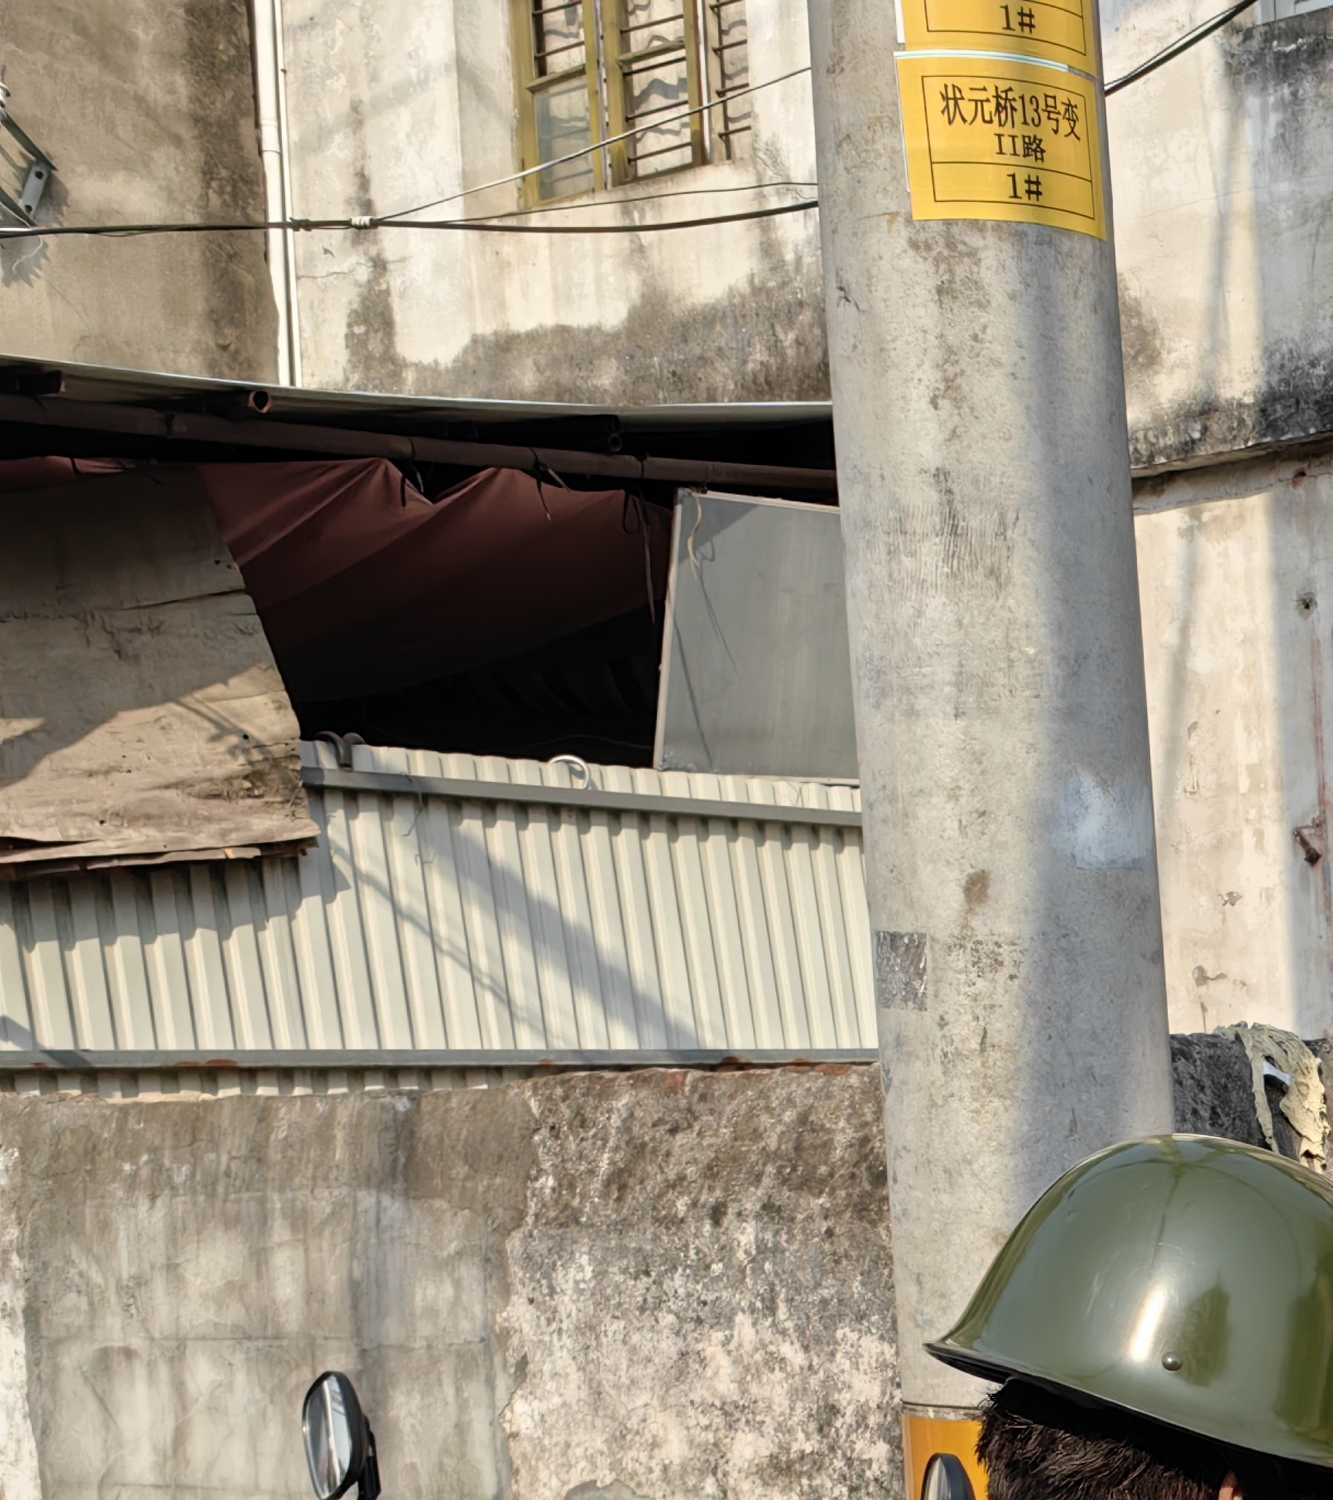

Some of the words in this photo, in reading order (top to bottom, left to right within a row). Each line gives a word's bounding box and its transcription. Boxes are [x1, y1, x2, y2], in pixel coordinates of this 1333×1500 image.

[1002, 5, 1036, 34] 1#
[940, 83, 1081, 141] 状元桥13号变
[1007, 173, 1043, 201] 1#
